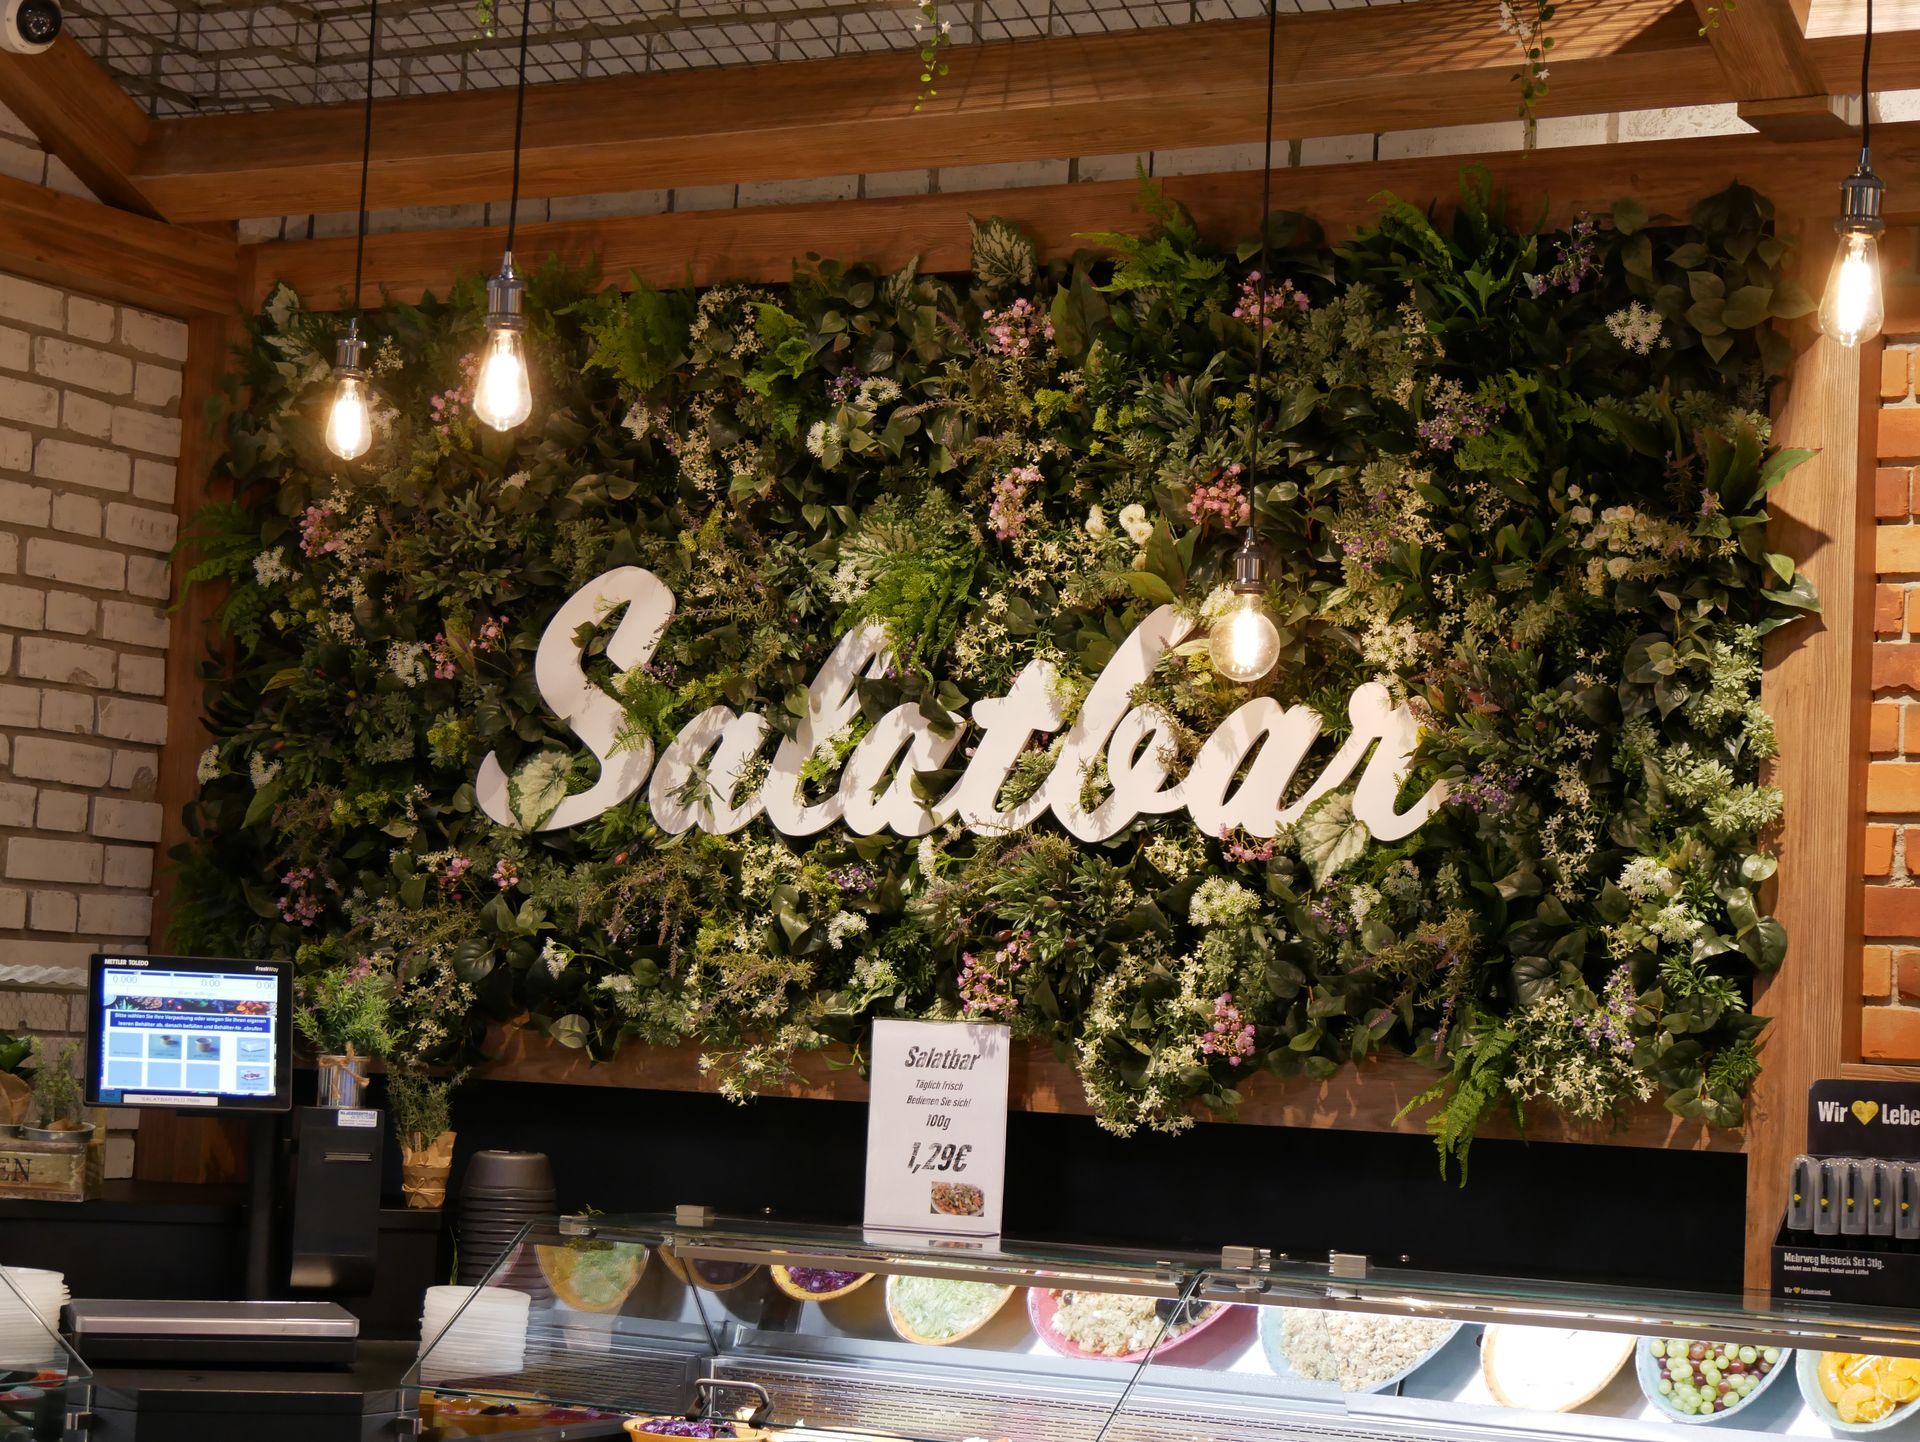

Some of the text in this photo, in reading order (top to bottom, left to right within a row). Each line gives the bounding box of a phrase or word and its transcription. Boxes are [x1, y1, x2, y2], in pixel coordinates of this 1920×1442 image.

[475, 565, 1450, 842] Salatbar
[104, 958, 149, 967] METTLER TOLEDO
[164, 1014, 193, 1022] Verpackung
[904, 1045, 981, 1071] Salatbar
[915, 1079, 964, 1091] Täglich frisch
[906, 1095, 972, 1108] Bedienen Sie sich!
[1817, 1100, 1848, 1123] Wir
[925, 1114, 951, 1131] 100g
[906, 1141, 973, 1174] 1,29€
[1784, 1252, 1819, 1266] Mehrweg
[1820, 1254, 1852, 1266] Besteck
[1852, 1256, 1866, 1267] Set
